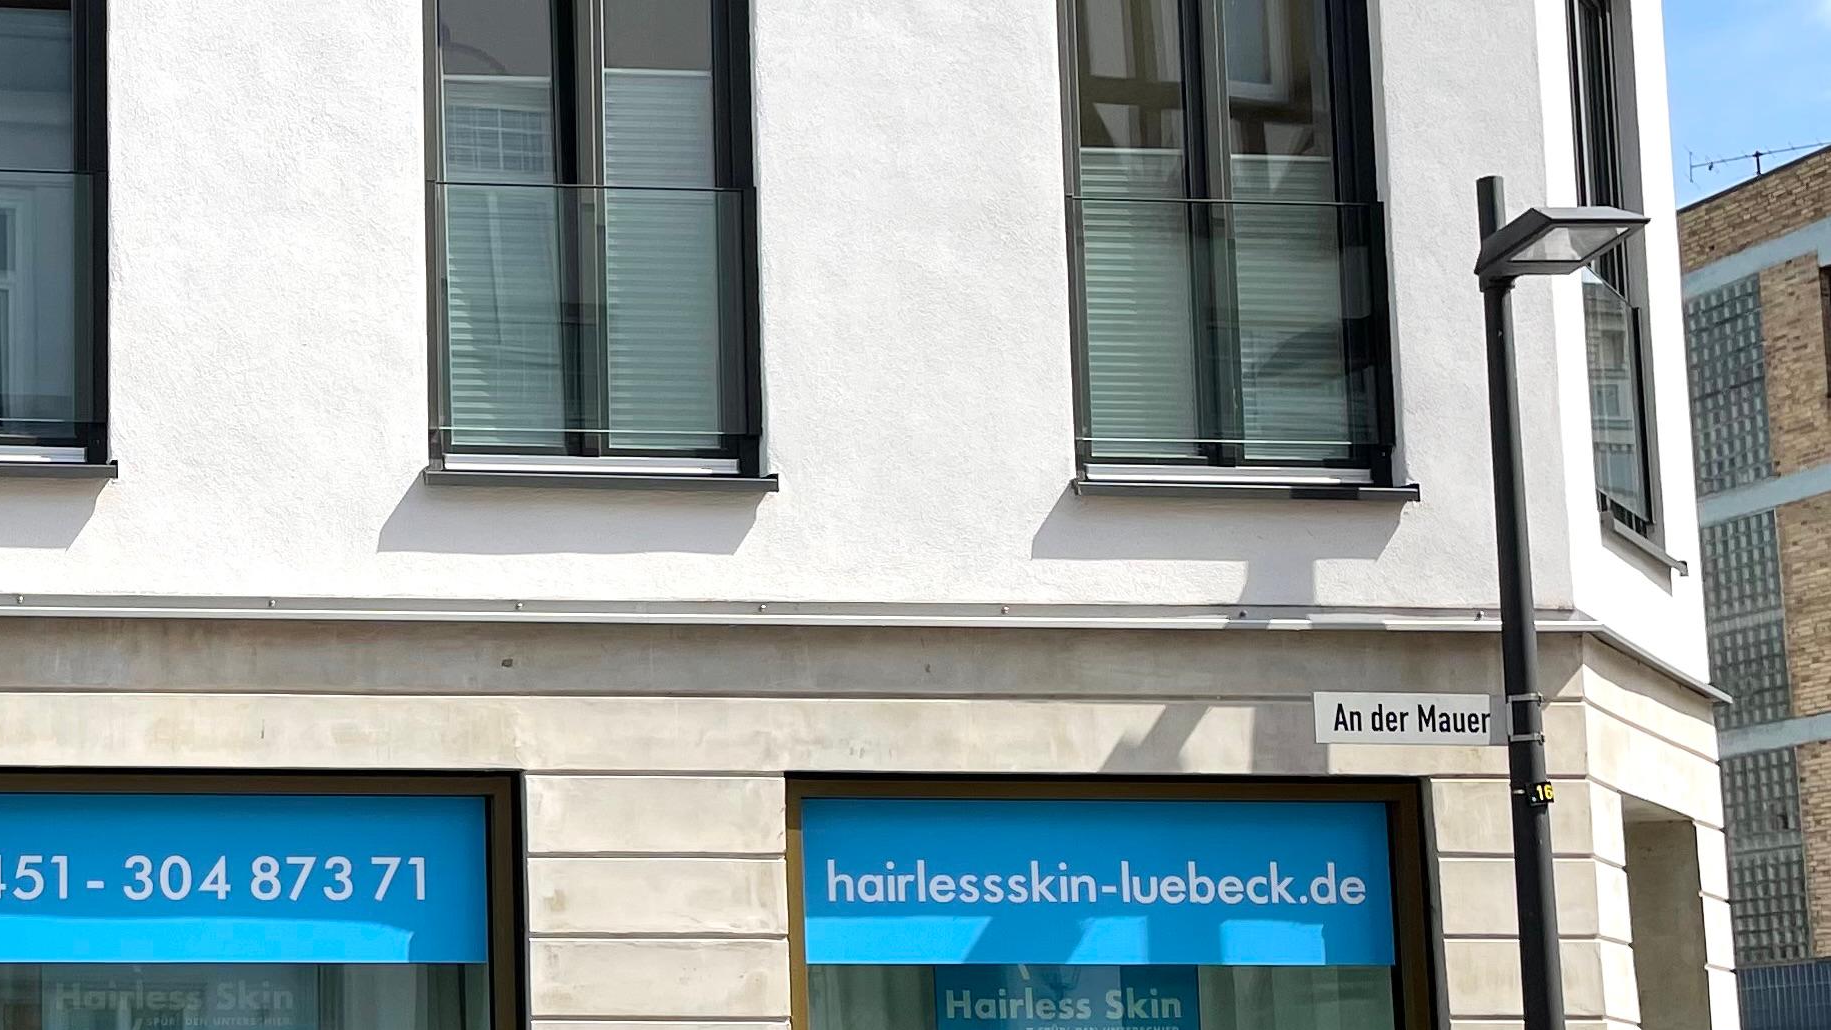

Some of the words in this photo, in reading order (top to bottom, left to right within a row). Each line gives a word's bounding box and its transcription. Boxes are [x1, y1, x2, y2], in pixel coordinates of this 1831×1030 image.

[1334, 703, 1362, 731] An
[1371, 703, 1409, 732] der
[1417, 704, 1491, 733] Mauer
[122, 855, 231, 900] 304
[249, 855, 354, 900] 873
[371, 856, 425, 900] 71
[827, 859, 1367, 905] hairlessskin-luebeck.de
[56, 980, 202, 1011] Hairless
[217, 980, 293, 1010] Skin
[946, 987, 1092, 1019] Hairless
[1105, 987, 1182, 1019] Skin
